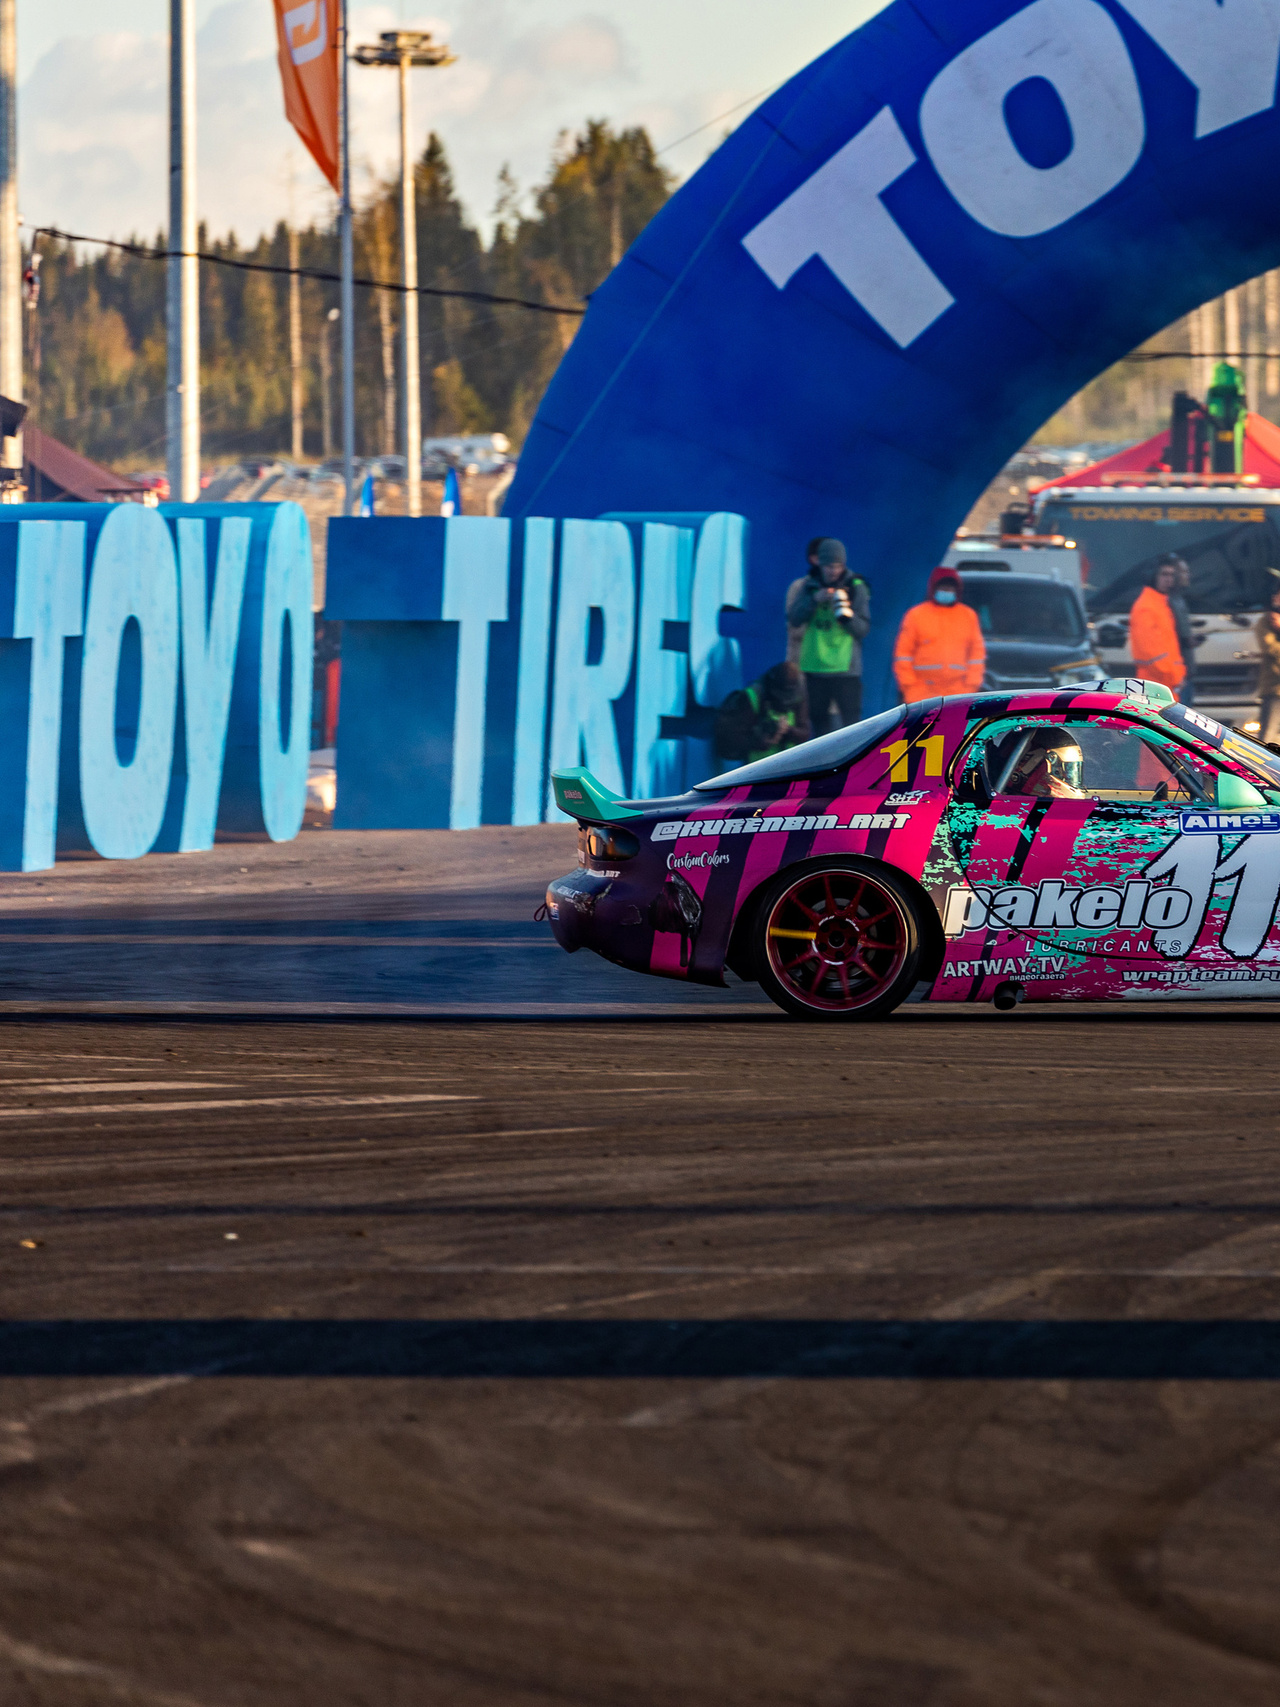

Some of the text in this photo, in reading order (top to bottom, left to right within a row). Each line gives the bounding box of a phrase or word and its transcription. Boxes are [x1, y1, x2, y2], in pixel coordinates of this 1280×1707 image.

[1069, 507, 1265, 522] TOWING SERVICE
[13, 502, 314, 872] TOYO
[880, 734, 945, 783] 11
[1184, 815, 1279, 829] AIMOL
[666, 850, 730, 871] CustomColors
[943, 879, 1194, 938] pakelo
[1025, 938, 1182, 954] LUBRICANTS
[943, 955, 1066, 979] ARTWAY.TV
[1009, 973, 1066, 982] видеогазета
